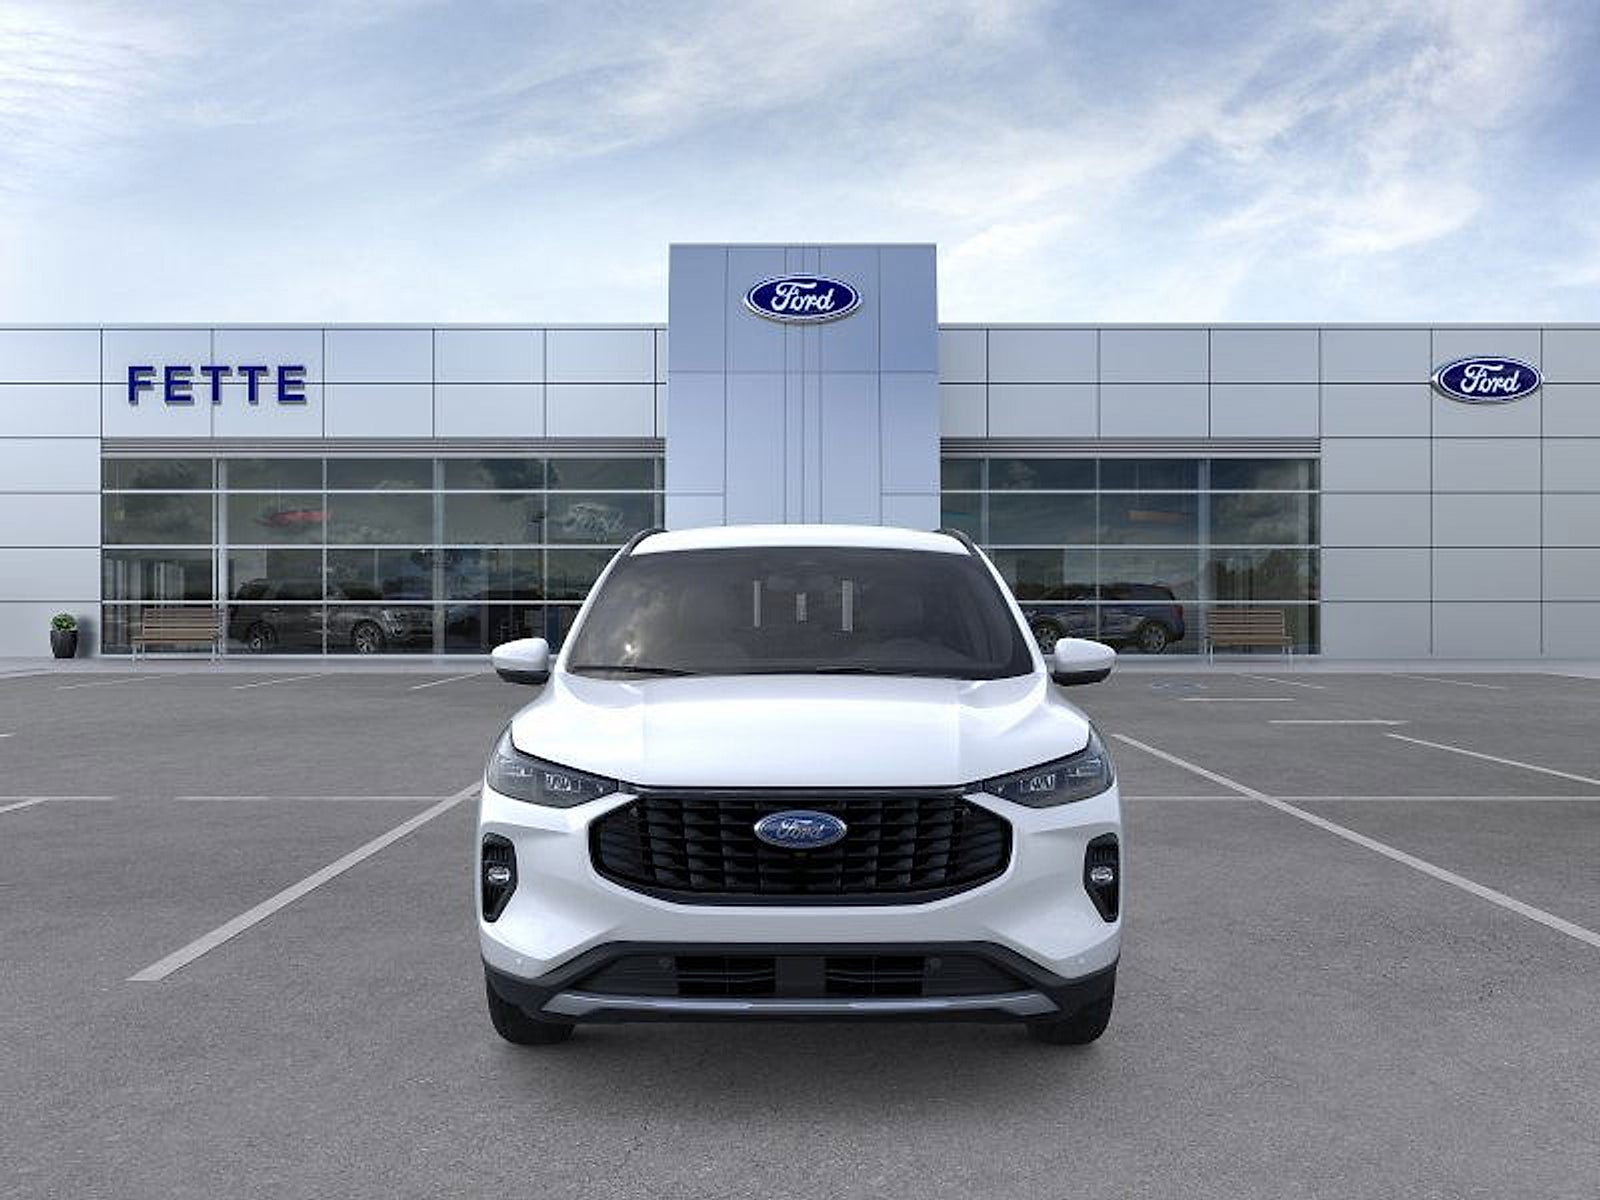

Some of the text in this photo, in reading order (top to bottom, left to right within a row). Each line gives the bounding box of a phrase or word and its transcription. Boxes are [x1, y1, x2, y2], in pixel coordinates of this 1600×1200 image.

[771, 281, 835, 311] Ford
[128, 365, 306, 404] FETTE
[1460, 364, 1521, 393] Ford
[775, 818, 827, 840] Ford
